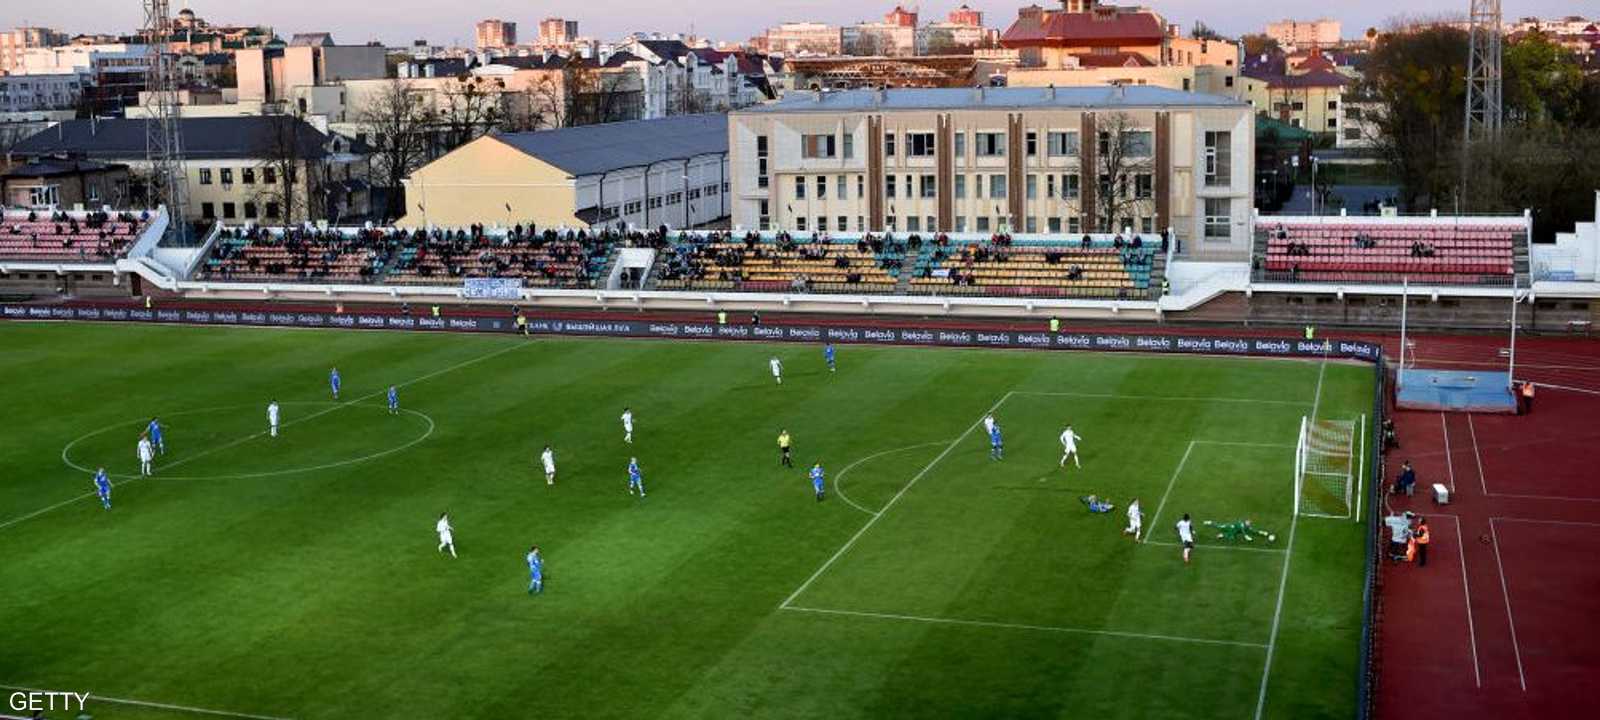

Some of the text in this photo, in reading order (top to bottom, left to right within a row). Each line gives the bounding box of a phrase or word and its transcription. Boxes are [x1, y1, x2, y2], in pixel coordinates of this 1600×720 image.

[940, 332, 971, 342] Belavia
[977, 333, 1009, 342] Belavia
[1018, 334, 1050, 344] Belavia
[1057, 335, 1089, 345] Belavia
[1096, 336, 1129, 346] Belavia
[1137, 337, 1170, 347] Belavia
[1177, 338, 1211, 348] Belavia
[1214, 340, 1248, 350] Belavia
[1255, 340, 1290, 351] Belavia
[1340, 343, 1371, 355] Belavia
